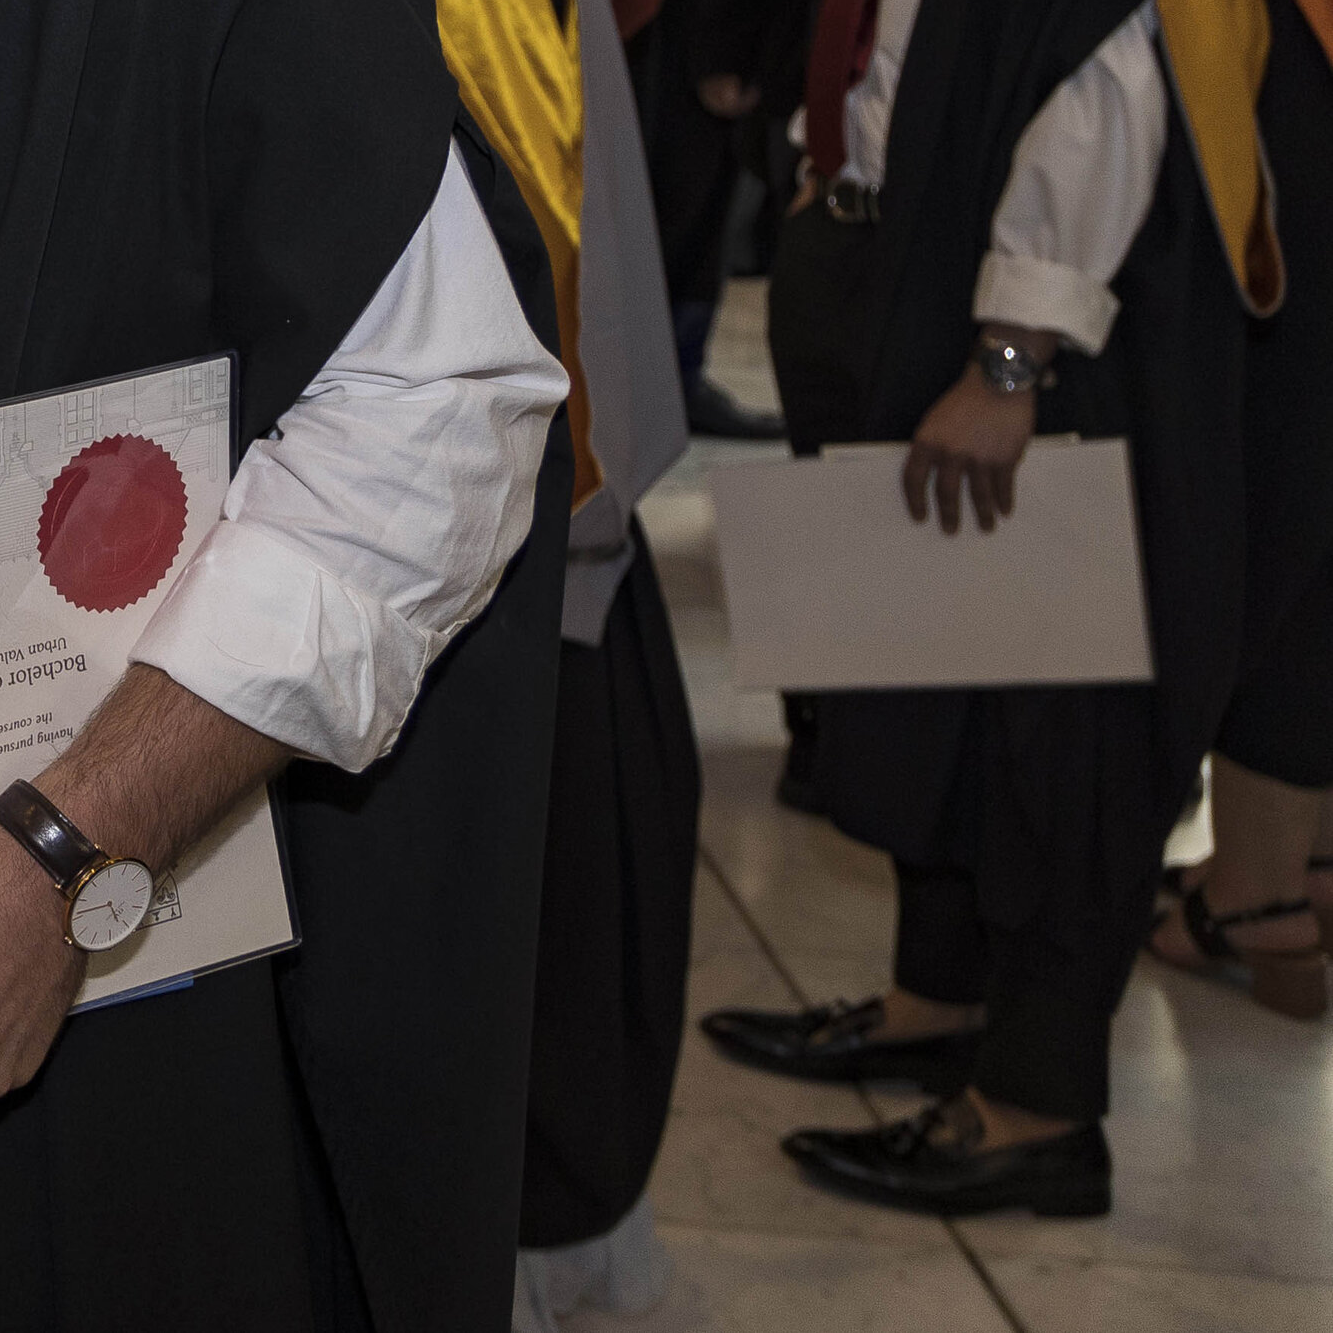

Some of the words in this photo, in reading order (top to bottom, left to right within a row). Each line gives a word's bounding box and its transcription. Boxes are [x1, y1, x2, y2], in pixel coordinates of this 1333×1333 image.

[27, 637, 67, 655] Urban
[7, 654, 88, 686] Bachelor
[35, 711, 53, 725] the
[37, 727, 77, 744] having
